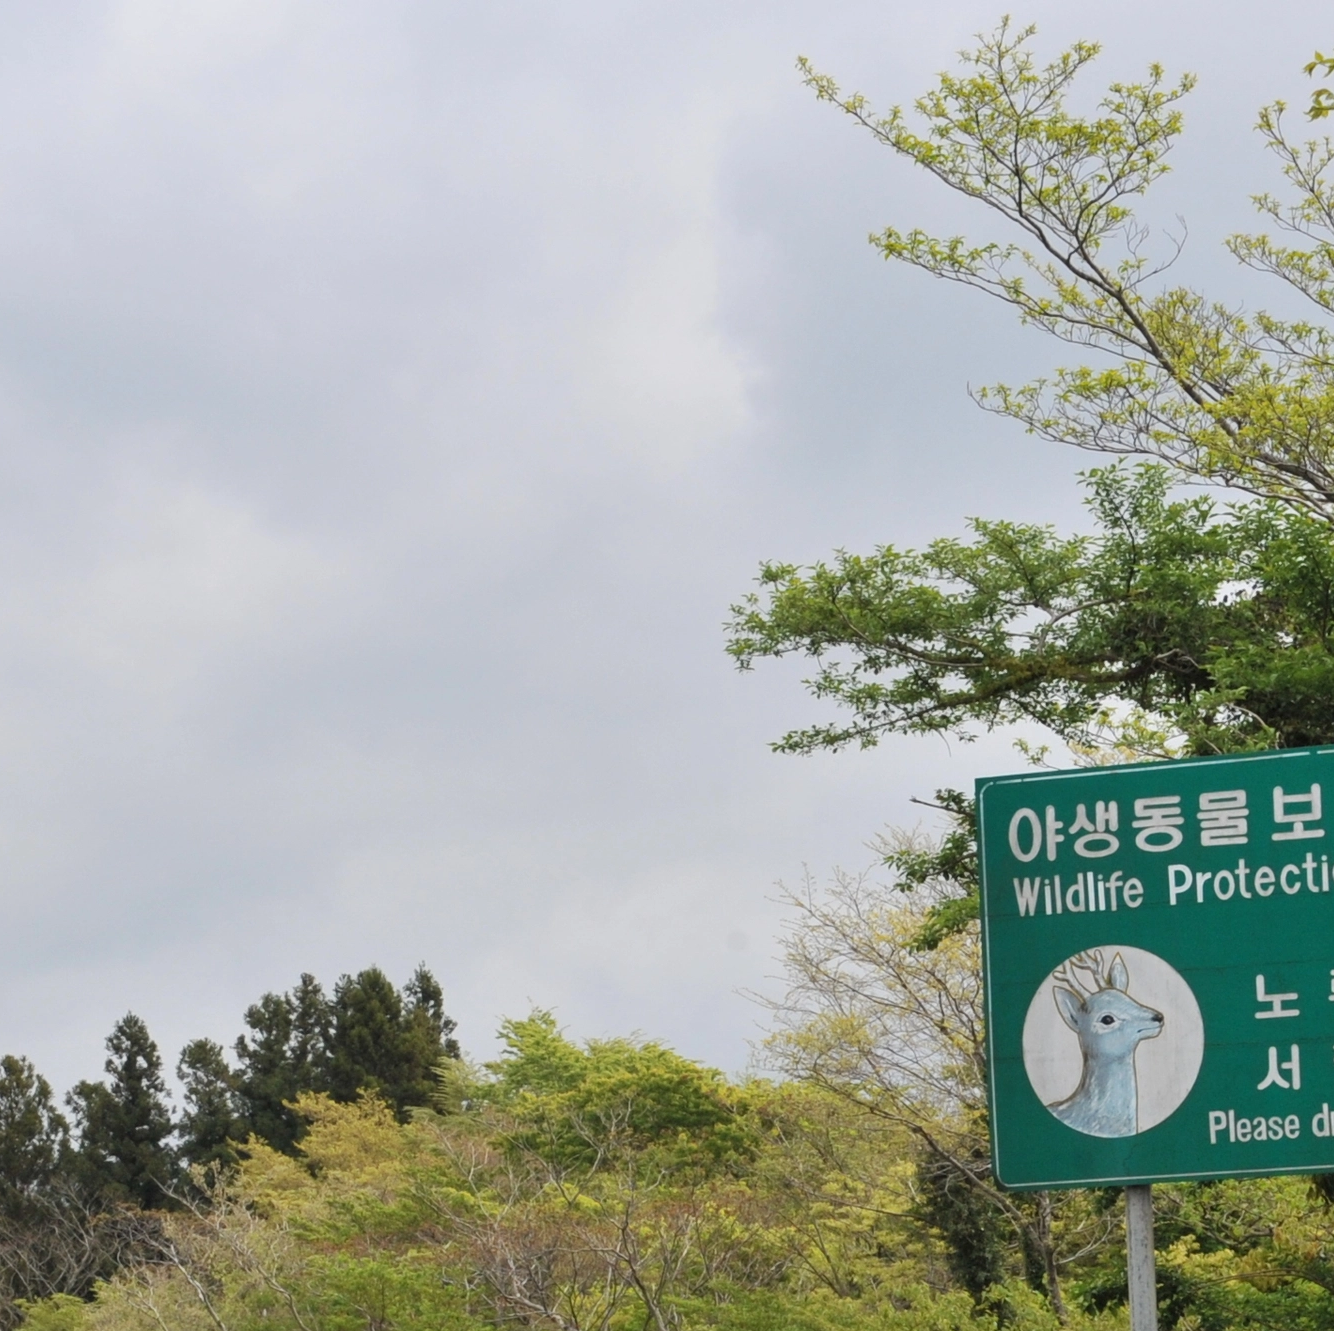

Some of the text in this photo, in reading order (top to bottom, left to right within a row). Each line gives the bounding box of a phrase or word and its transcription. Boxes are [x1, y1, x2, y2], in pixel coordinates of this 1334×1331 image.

[1007, 789, 1250, 863] 야생동물
[1013, 870, 1144, 917] Wildlife
[1208, 1109, 1300, 1144] Please
